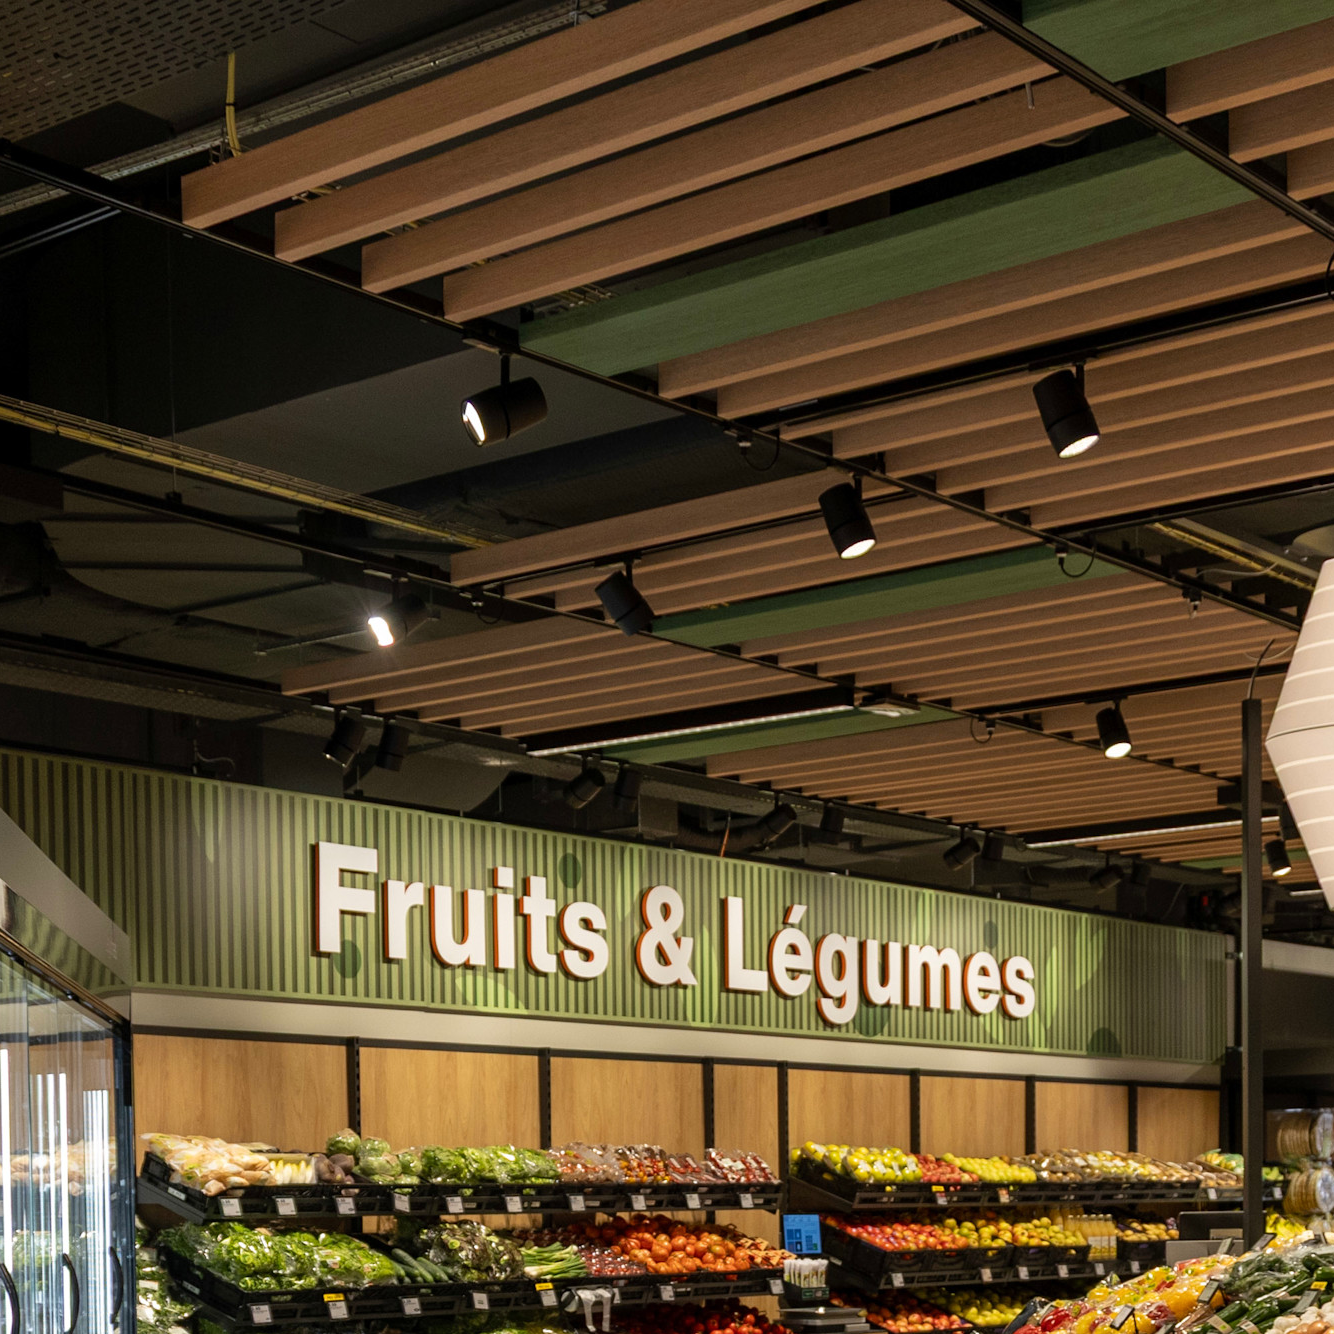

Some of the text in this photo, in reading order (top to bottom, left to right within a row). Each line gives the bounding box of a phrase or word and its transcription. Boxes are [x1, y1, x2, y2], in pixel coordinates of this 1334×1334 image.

[315, 841, 1036, 1026] Fruits & Légumes
